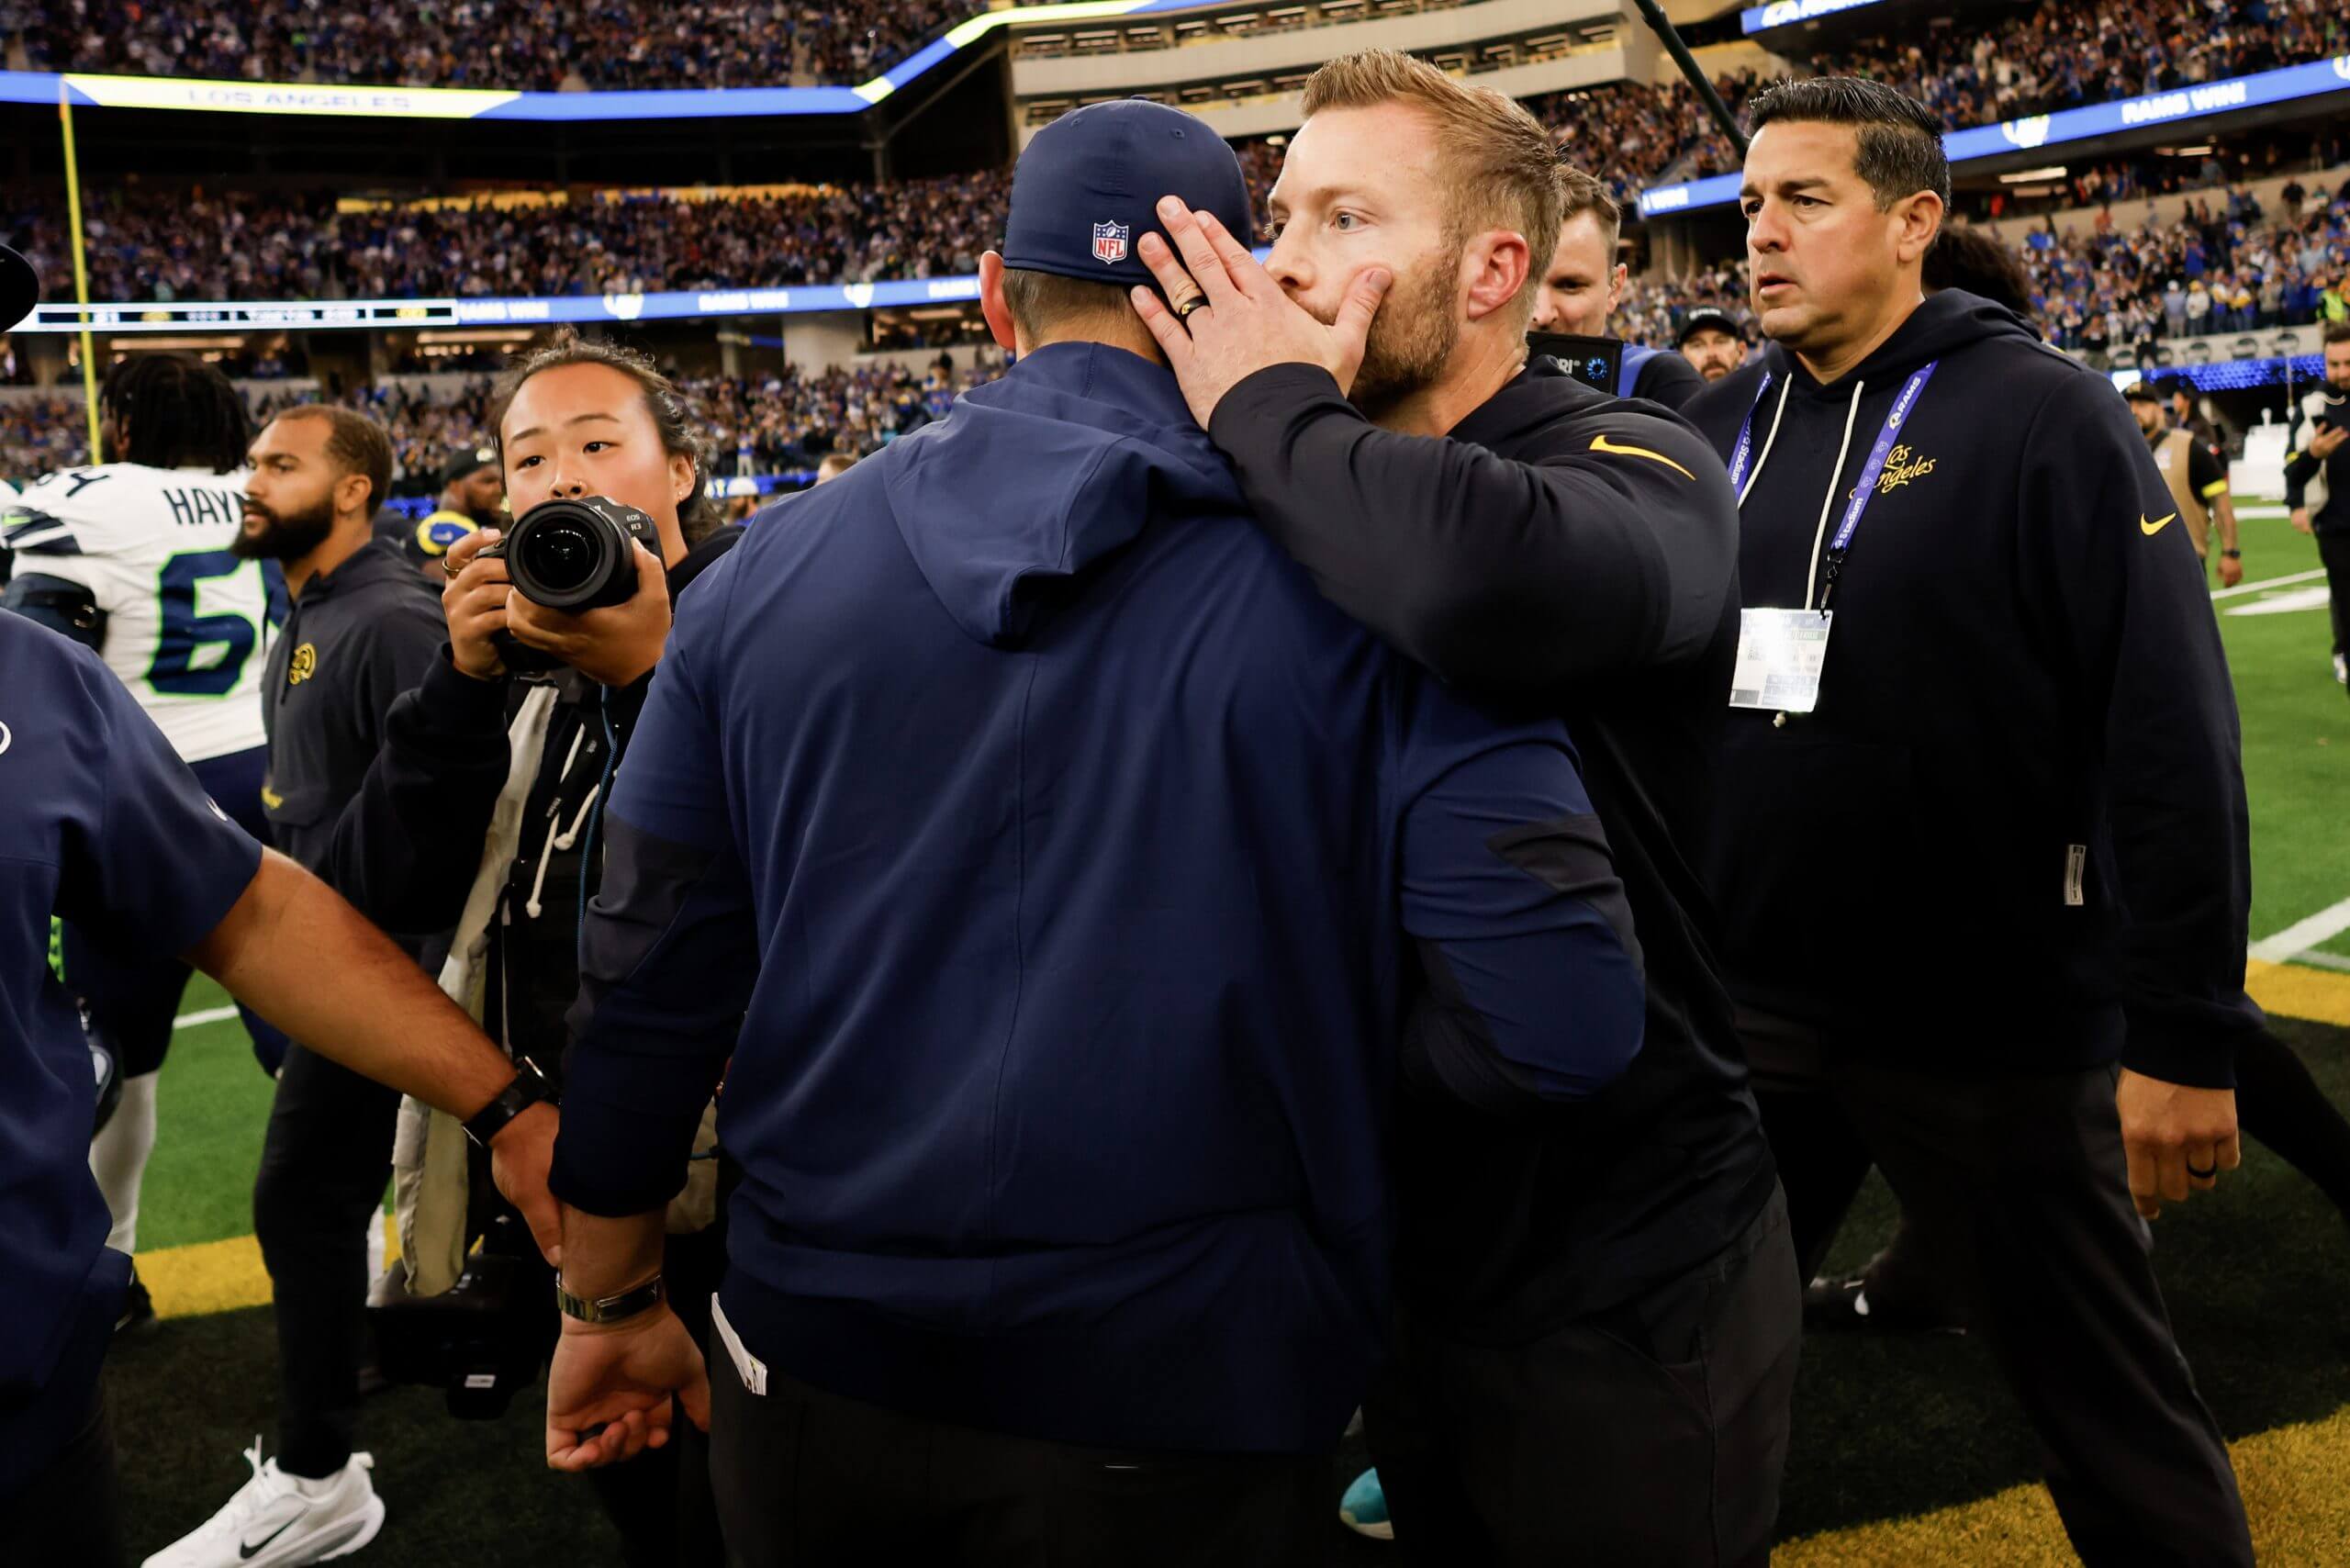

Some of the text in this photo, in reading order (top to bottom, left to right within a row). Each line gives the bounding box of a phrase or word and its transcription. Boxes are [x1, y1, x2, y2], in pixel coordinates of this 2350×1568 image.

[188, 88, 410, 109] LOS ANGELES
[2121, 93, 2188, 124] RAMS
[1097, 239, 1125, 259] NFL
[1897, 376, 1922, 409] RAMS
[1731, 445, 1751, 485] Stadium
[1884, 444, 1912, 470] Los
[1849, 455, 1937, 499] ngeles
[626, 513, 641, 522] EOS
[1839, 498, 1863, 540] Stadium
